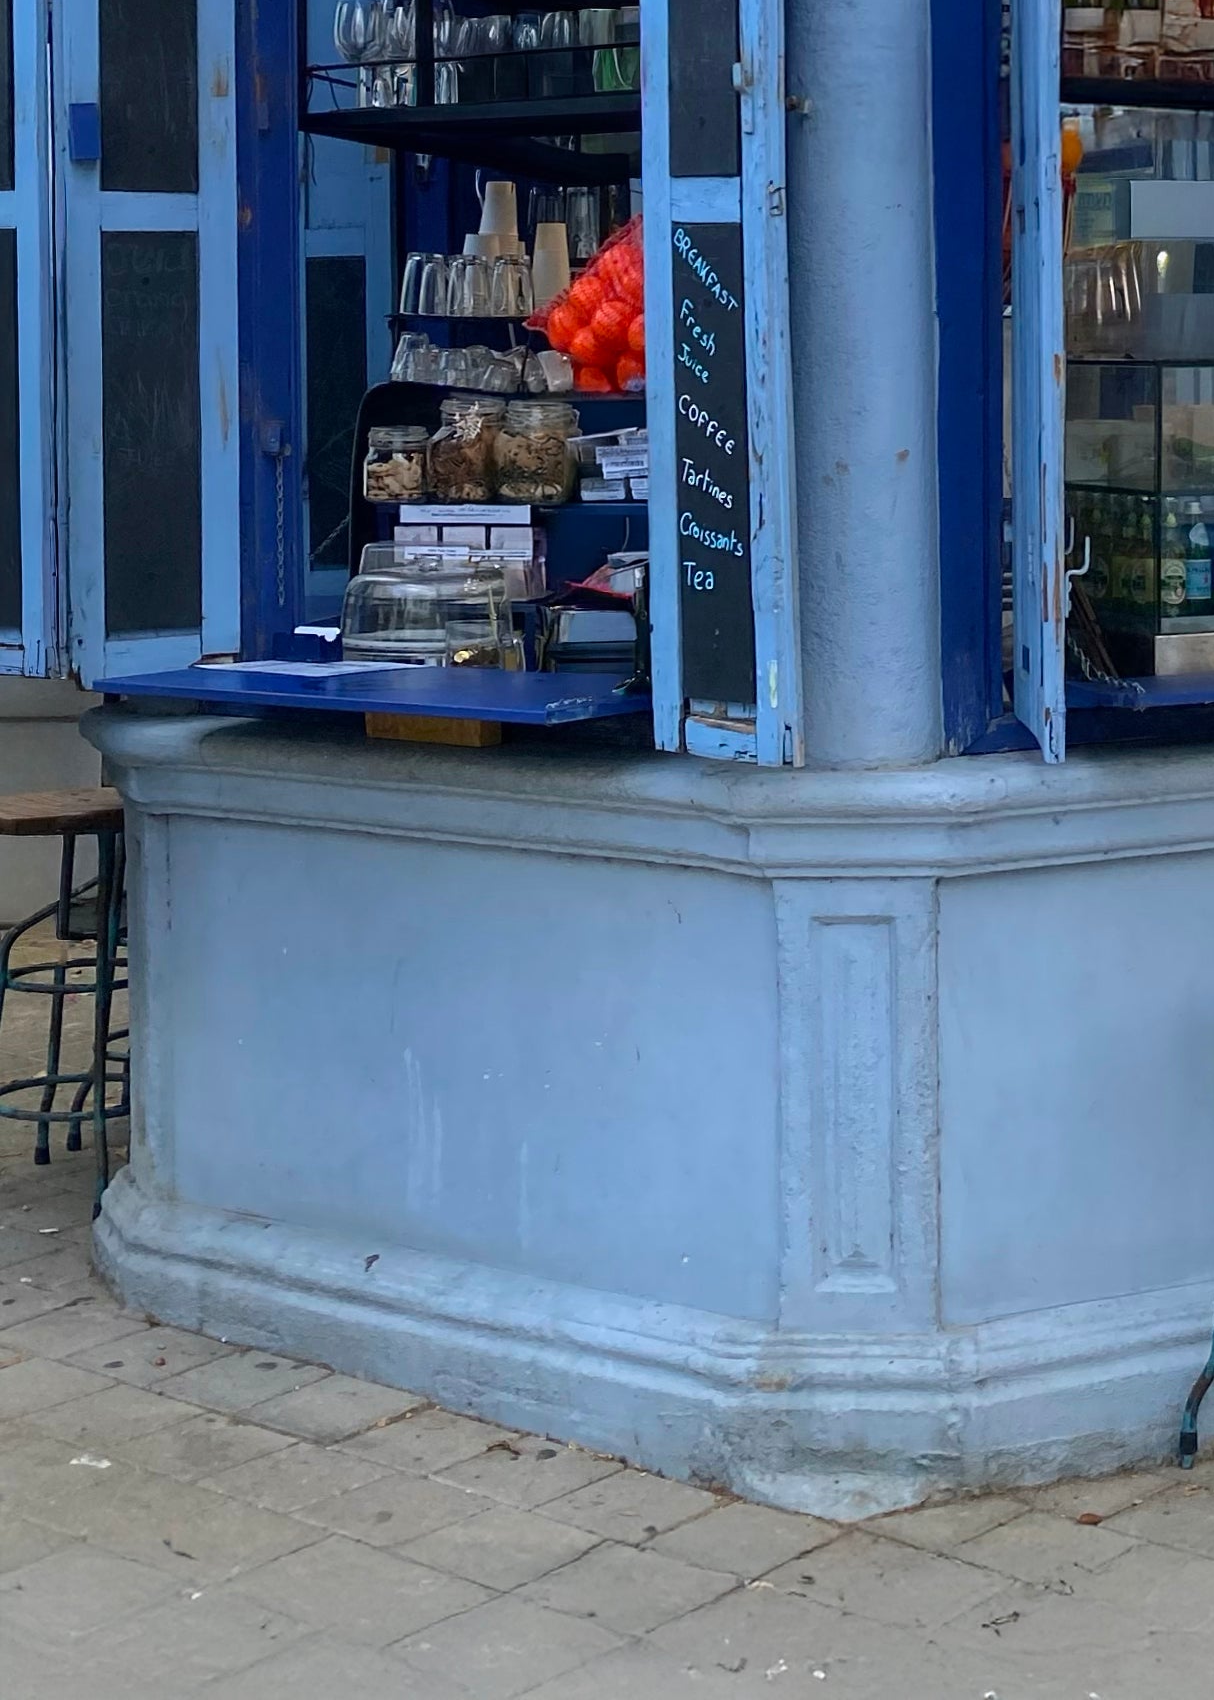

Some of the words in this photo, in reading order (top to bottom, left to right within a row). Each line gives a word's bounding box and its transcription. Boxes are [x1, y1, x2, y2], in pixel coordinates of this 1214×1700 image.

[673, 227, 739, 313] BREAKFAST
[678, 298, 717, 357] Fresh
[676, 341, 710, 384] Juice
[678, 393, 736, 456] COFFEE
[681, 457, 734, 510] Tartines
[679, 511, 744, 558] Croissants
[683, 561, 715, 591] Tea
